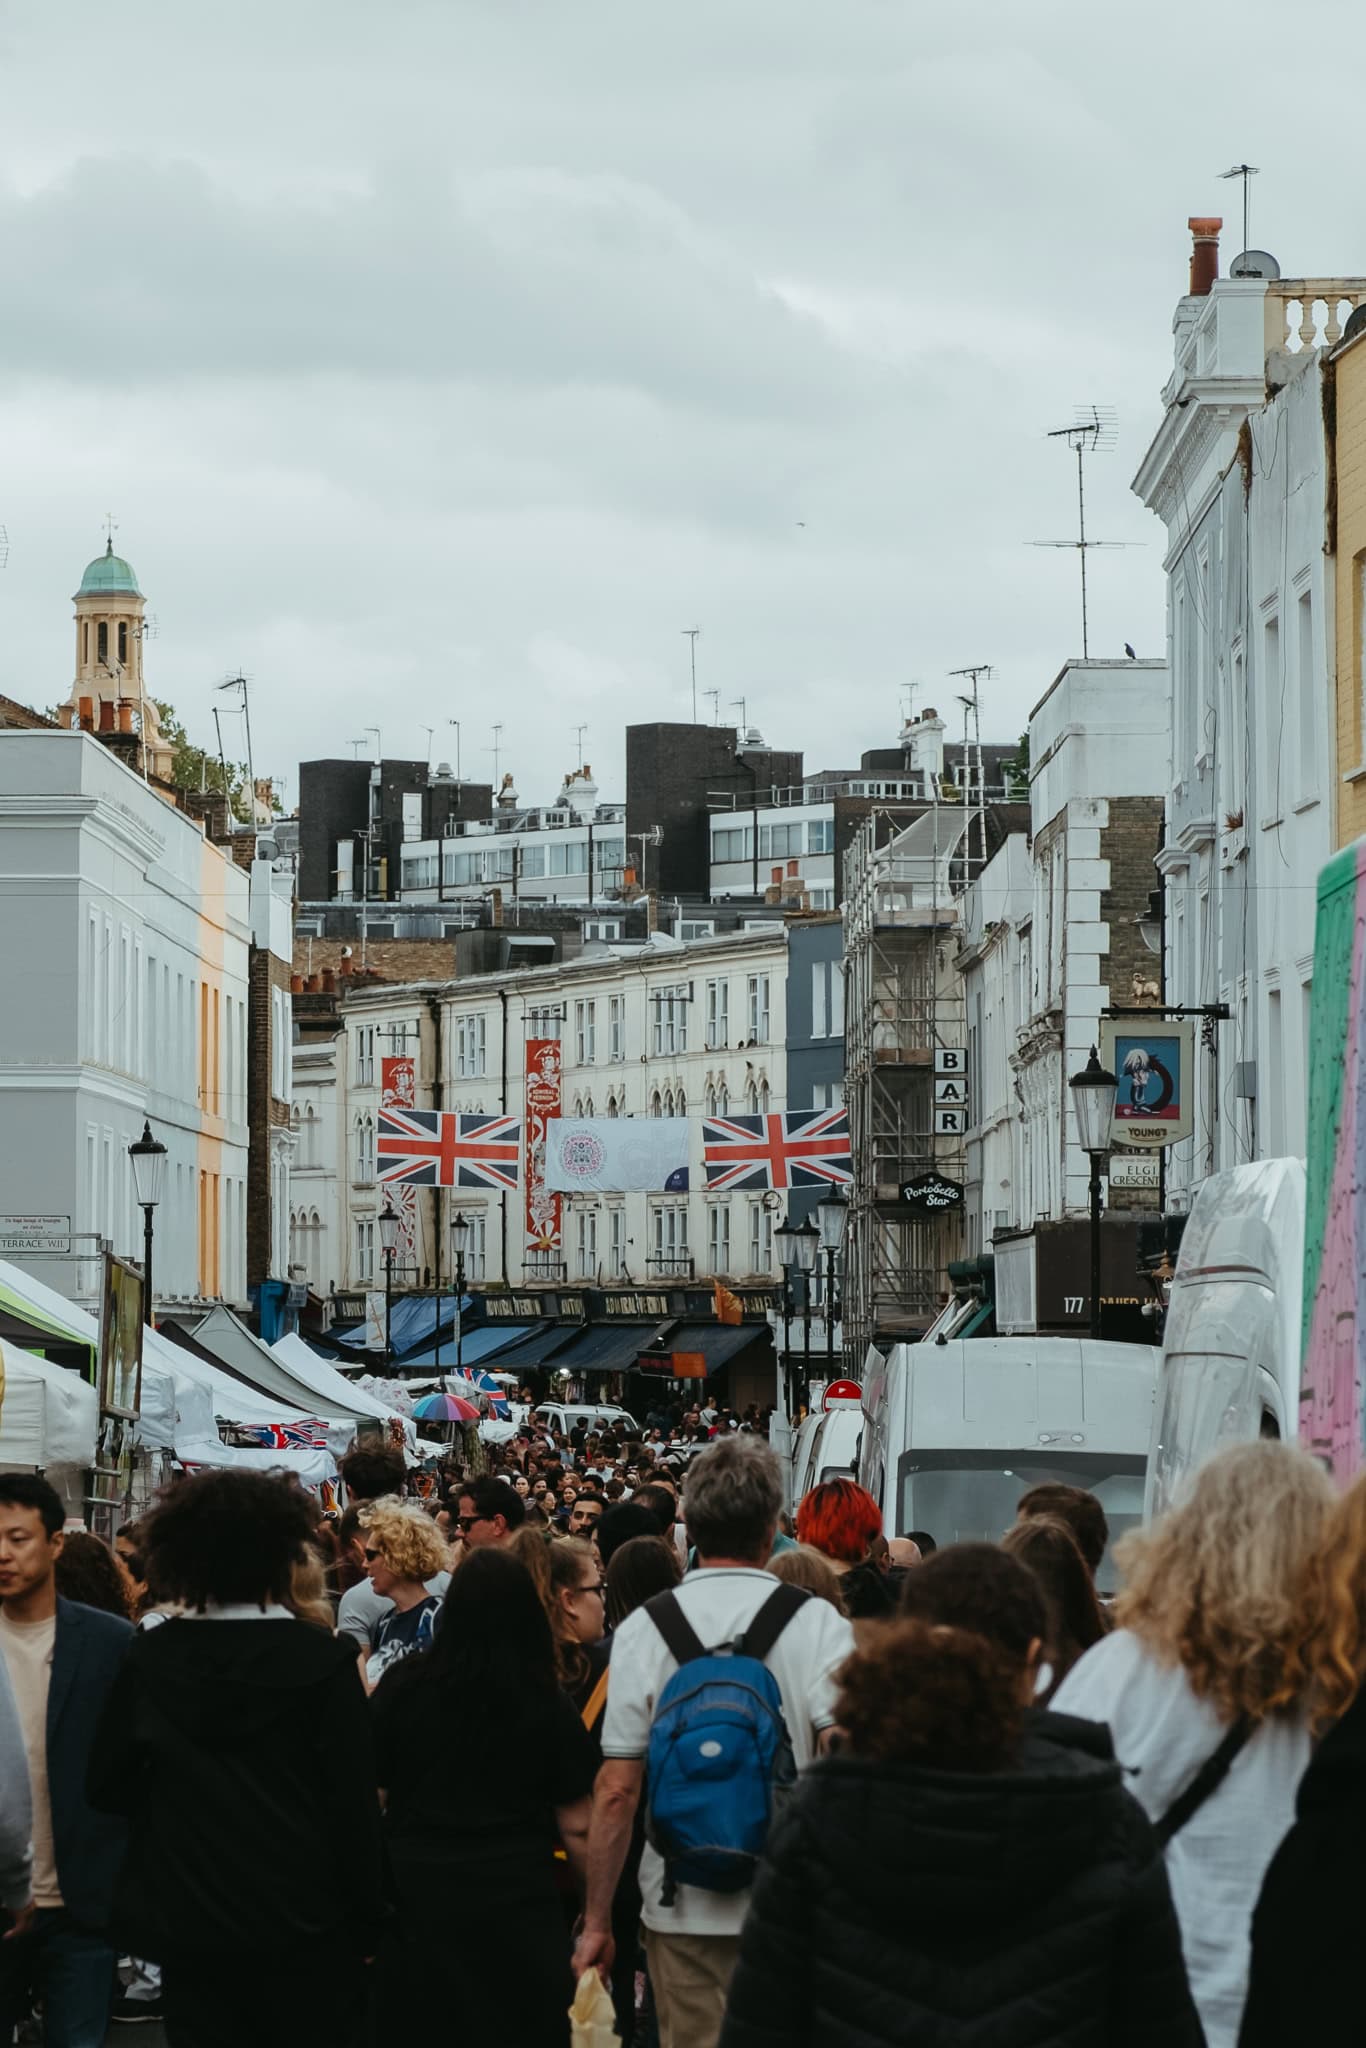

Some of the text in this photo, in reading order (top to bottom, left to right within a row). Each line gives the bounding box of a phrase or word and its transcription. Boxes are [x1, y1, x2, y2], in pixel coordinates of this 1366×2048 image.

[942, 1052, 960, 1130] BAR
[1128, 1127, 1168, 1137] YOUNG'S
[1112, 1176, 1160, 1185] CRESCENT
[904, 1182, 959, 1200] Portobello
[926, 1194, 950, 1206] Star
[2, 1239, 44, 1248] TERRACE
[1064, 1297, 1084, 1313] 177
